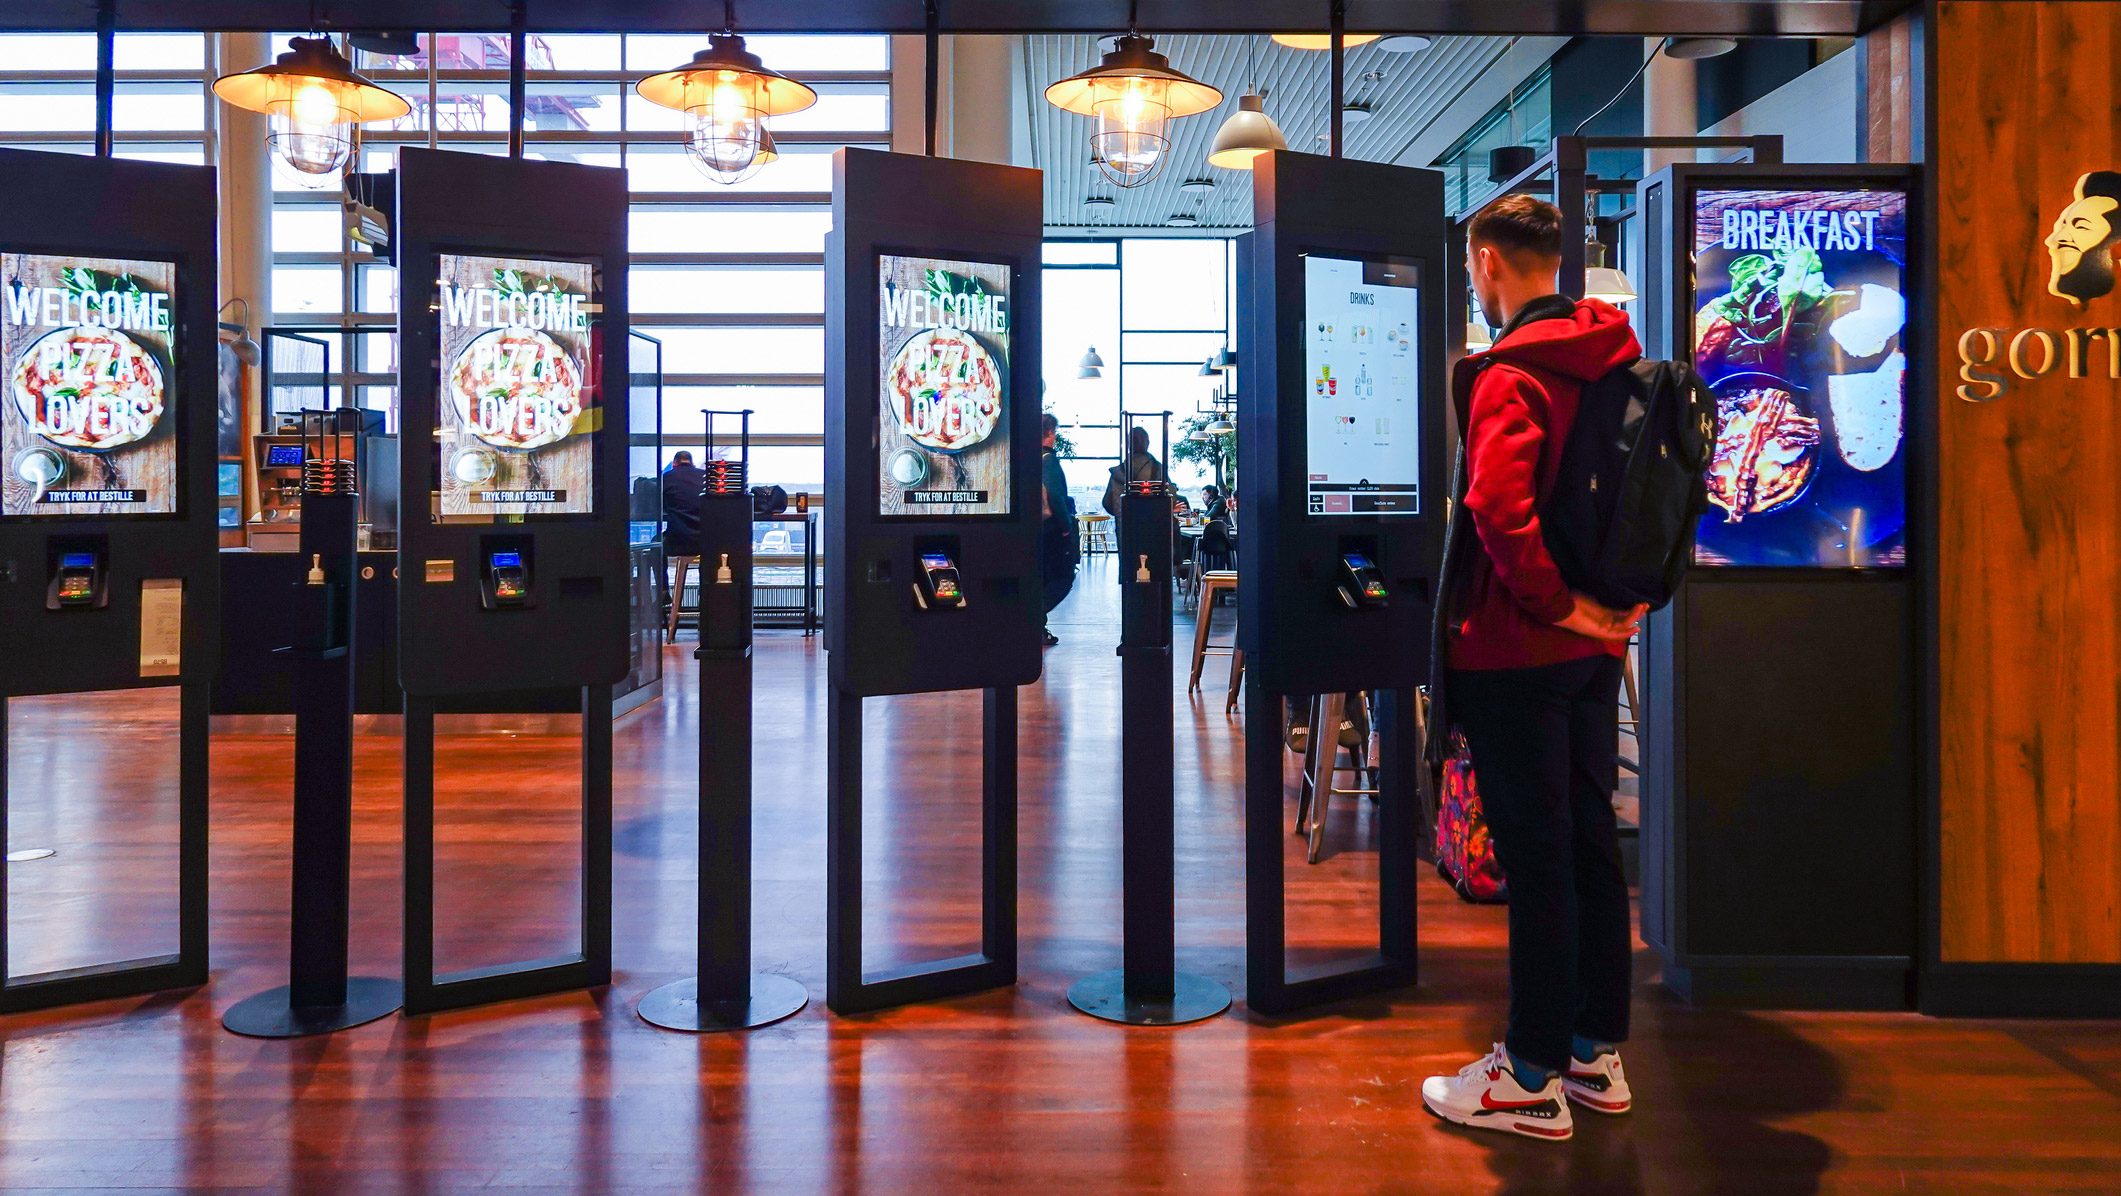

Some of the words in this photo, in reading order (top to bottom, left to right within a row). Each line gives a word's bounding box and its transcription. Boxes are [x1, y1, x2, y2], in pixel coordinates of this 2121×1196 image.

[1722, 209, 1880, 251] BREAKFAST
[6, 285, 170, 331] WELCOME
[444, 286, 587, 332] WELCOME
[883, 287, 1006, 333] WELCOME
[1349, 291, 1375, 306] DRINKS
[40, 341, 137, 382] PIZZA
[474, 342, 558, 383] PIZZA
[908, 343, 981, 384] PIZZA
[29, 394, 150, 435] LOVERS
[463, 394, 571, 435] LOVERS
[899, 395, 991, 436] LOVERS
[48, 491, 70, 502] TRYK
[71, 491, 87, 502] FOR
[87, 491, 98, 501] AT
[99, 490, 134, 501] BESTILLE
[481, 491, 500, 501] TRYK
[501, 491, 514, 501] FOR
[514, 491, 525, 501] AT
[525, 491, 556, 501] BESTILLE
[914, 491, 931, 502] TRYK
[931, 492, 943, 502] FOR
[943, 492, 951, 502] AT
[952, 492, 978, 502] BESTILLE
